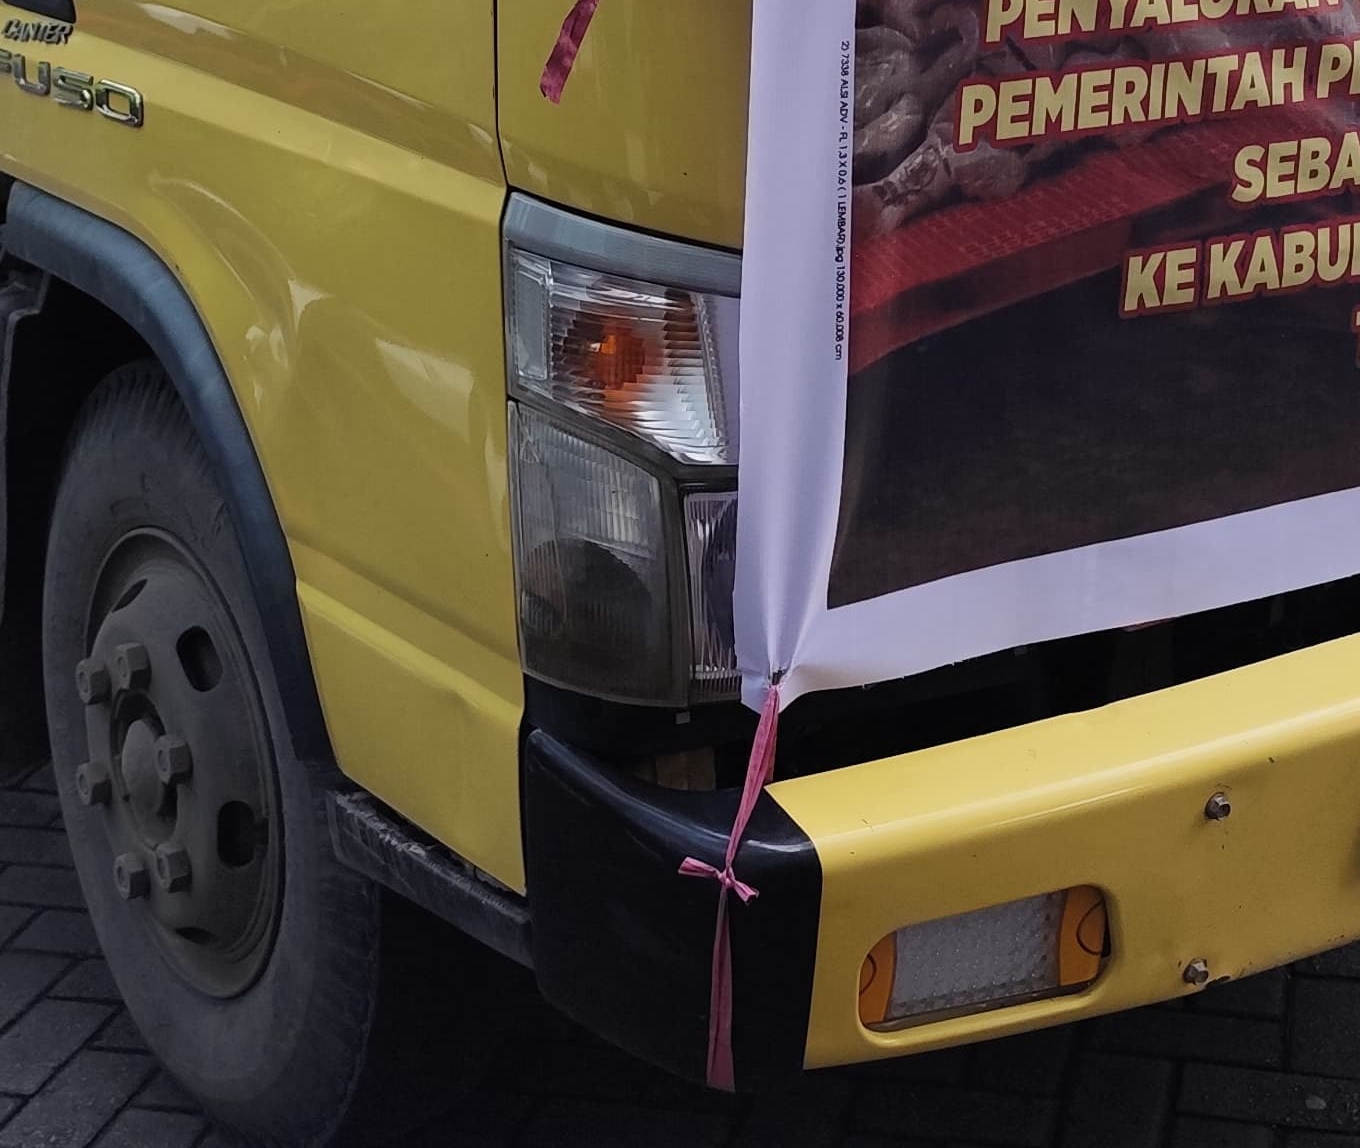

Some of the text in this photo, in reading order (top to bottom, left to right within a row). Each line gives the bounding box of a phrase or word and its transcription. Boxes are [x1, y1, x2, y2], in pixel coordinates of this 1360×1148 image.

[2, 18, 75, 45] CANTER
[958, 48, 1307, 144] PEMERINTAH
[839, 101, 849, 124] ADV
[1122, 253, 1202, 313] KE
[835, 344, 843, 361] cm
